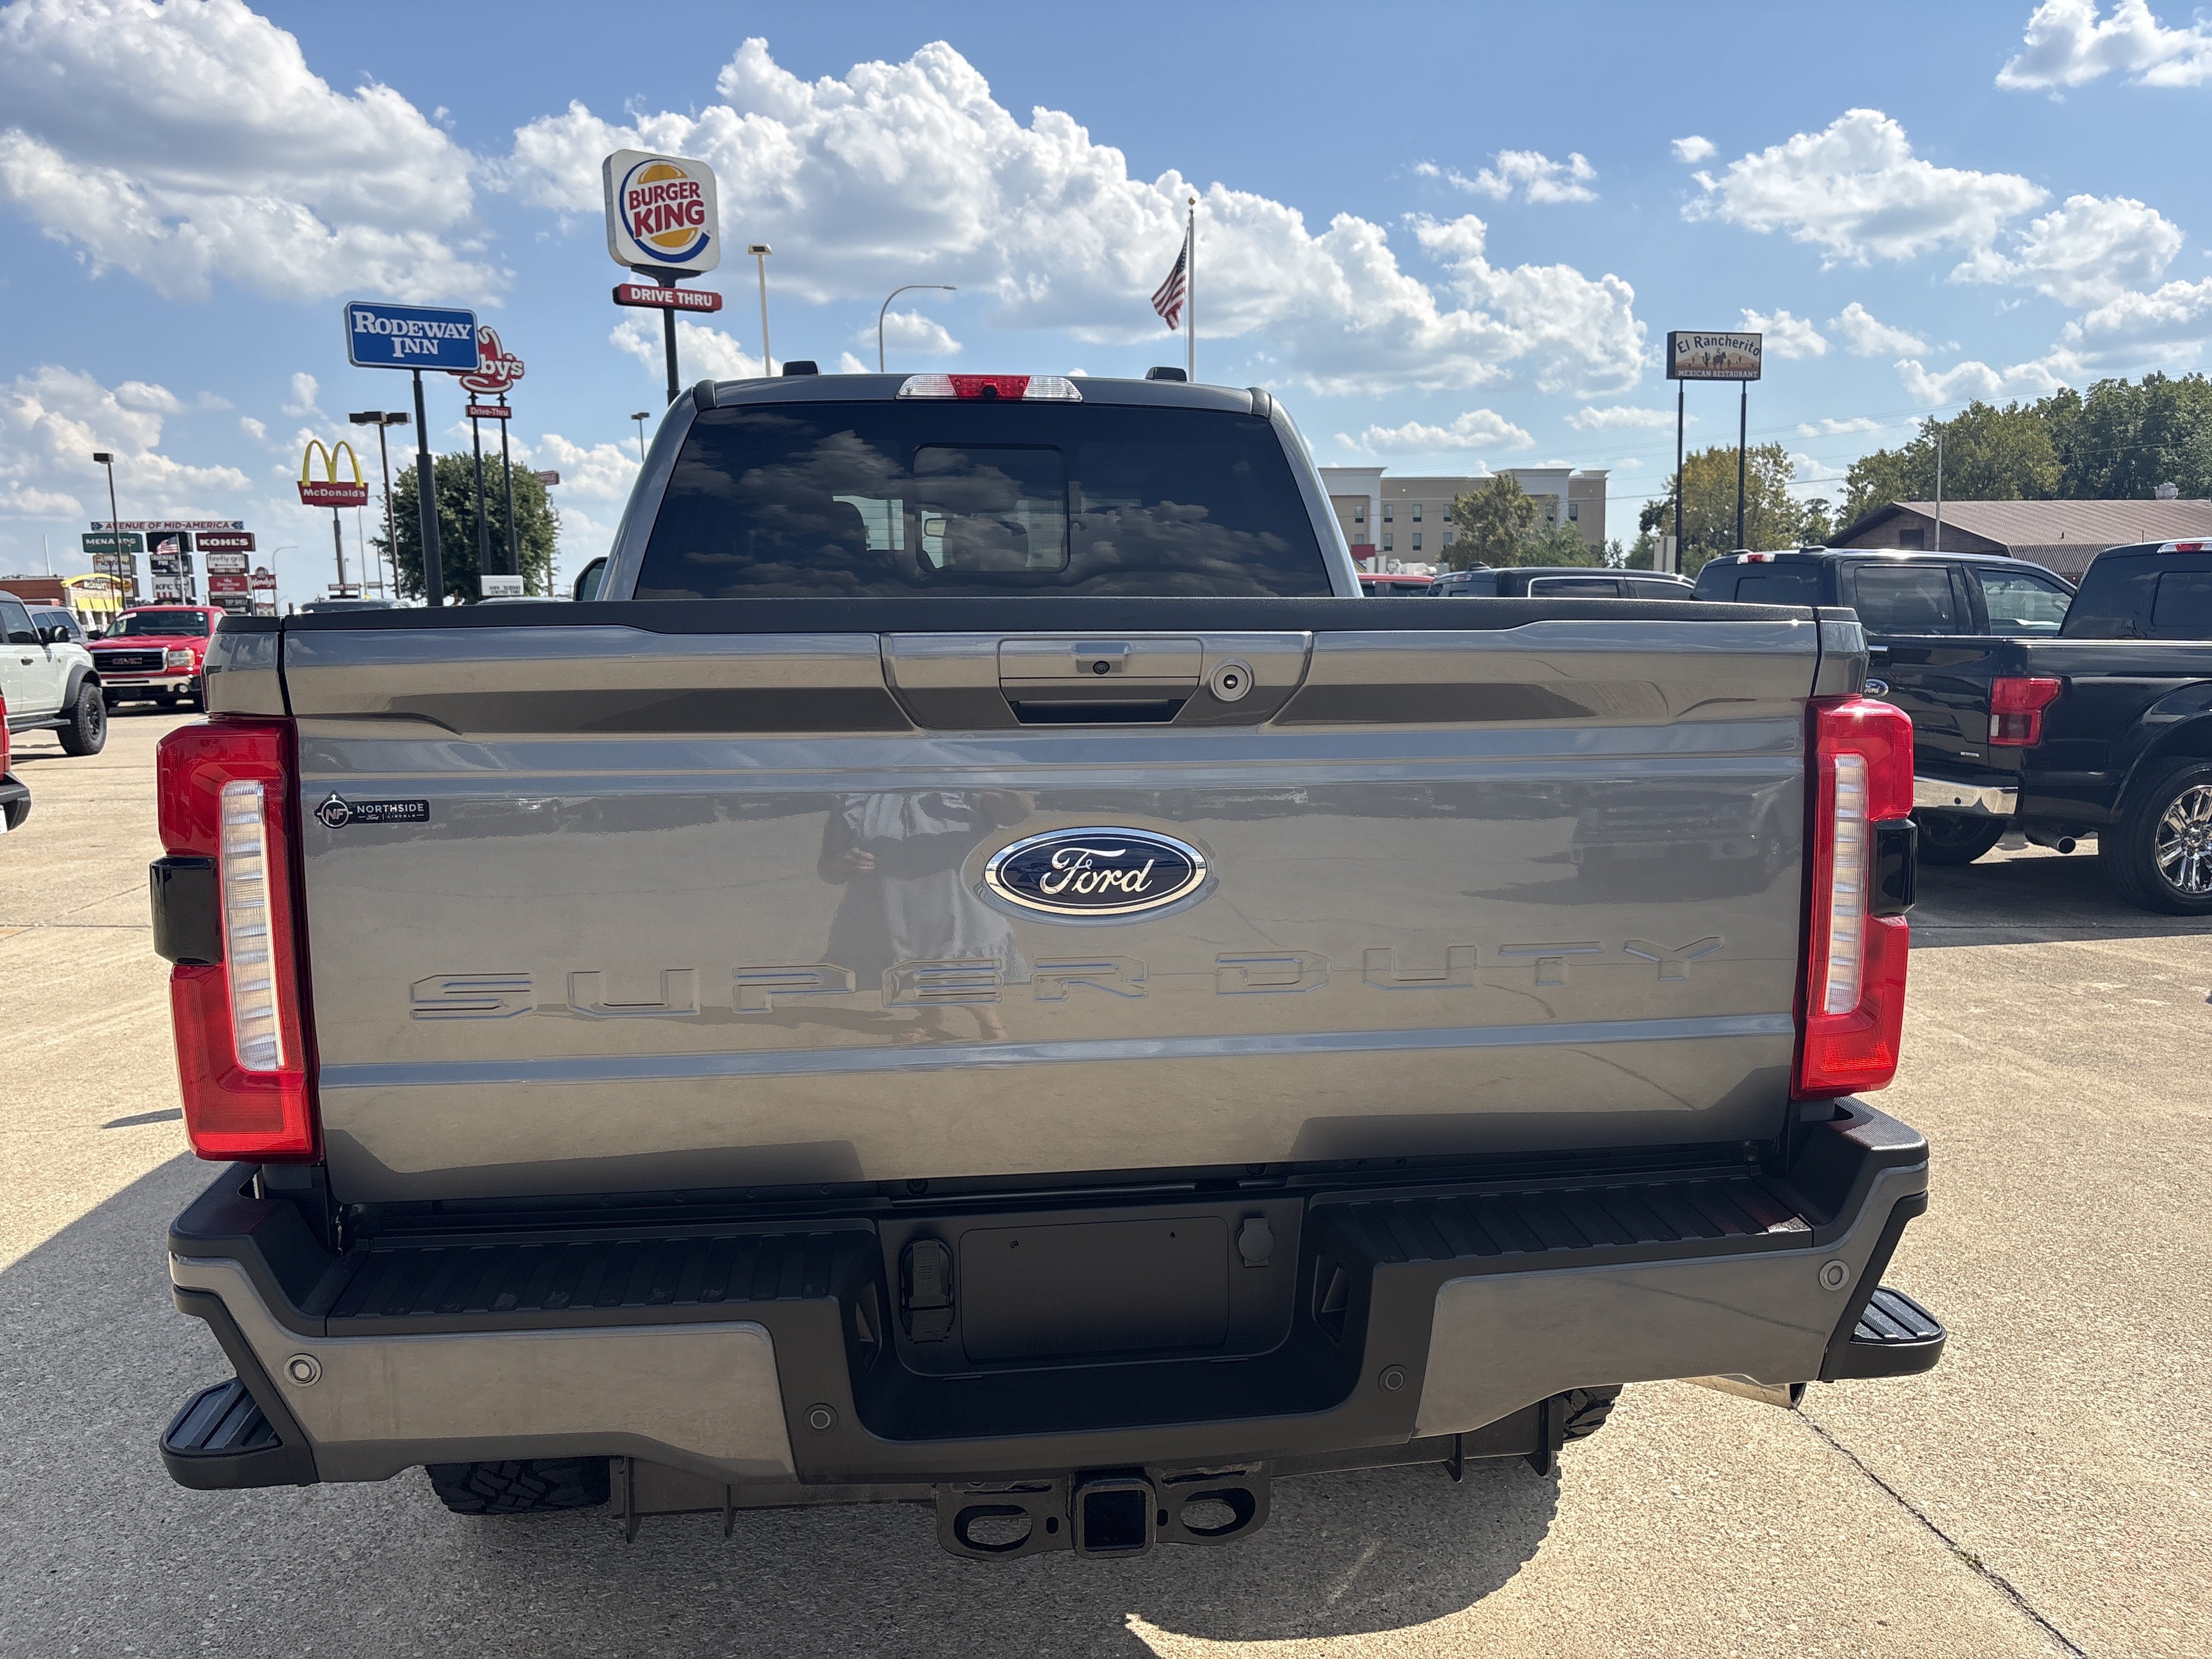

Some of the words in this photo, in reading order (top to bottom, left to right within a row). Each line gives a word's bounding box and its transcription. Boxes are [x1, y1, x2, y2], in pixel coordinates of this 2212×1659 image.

[629, 182, 701, 211] BURGER
[634, 200, 706, 239] KING
[631, 287, 674, 303] DRIVE
[677, 292, 713, 307] THRU
[353, 311, 472, 340] RODEWAY
[392, 337, 439, 358] INN
[1677, 339, 1690, 354] El
[1694, 334, 1760, 357] Rancherito
[473, 354, 523, 381] by's
[470, 407, 509, 416] Drive-Thru
[303, 488, 365, 498] McDonald's
[199, 538, 249, 546] KOHL'S
[357, 804, 424, 814] NORTHSIDE
[1039, 847, 1155, 894] Ford
[410, 954, 1149, 1021] SUPER
[1215, 936, 1724, 997] DUTY
